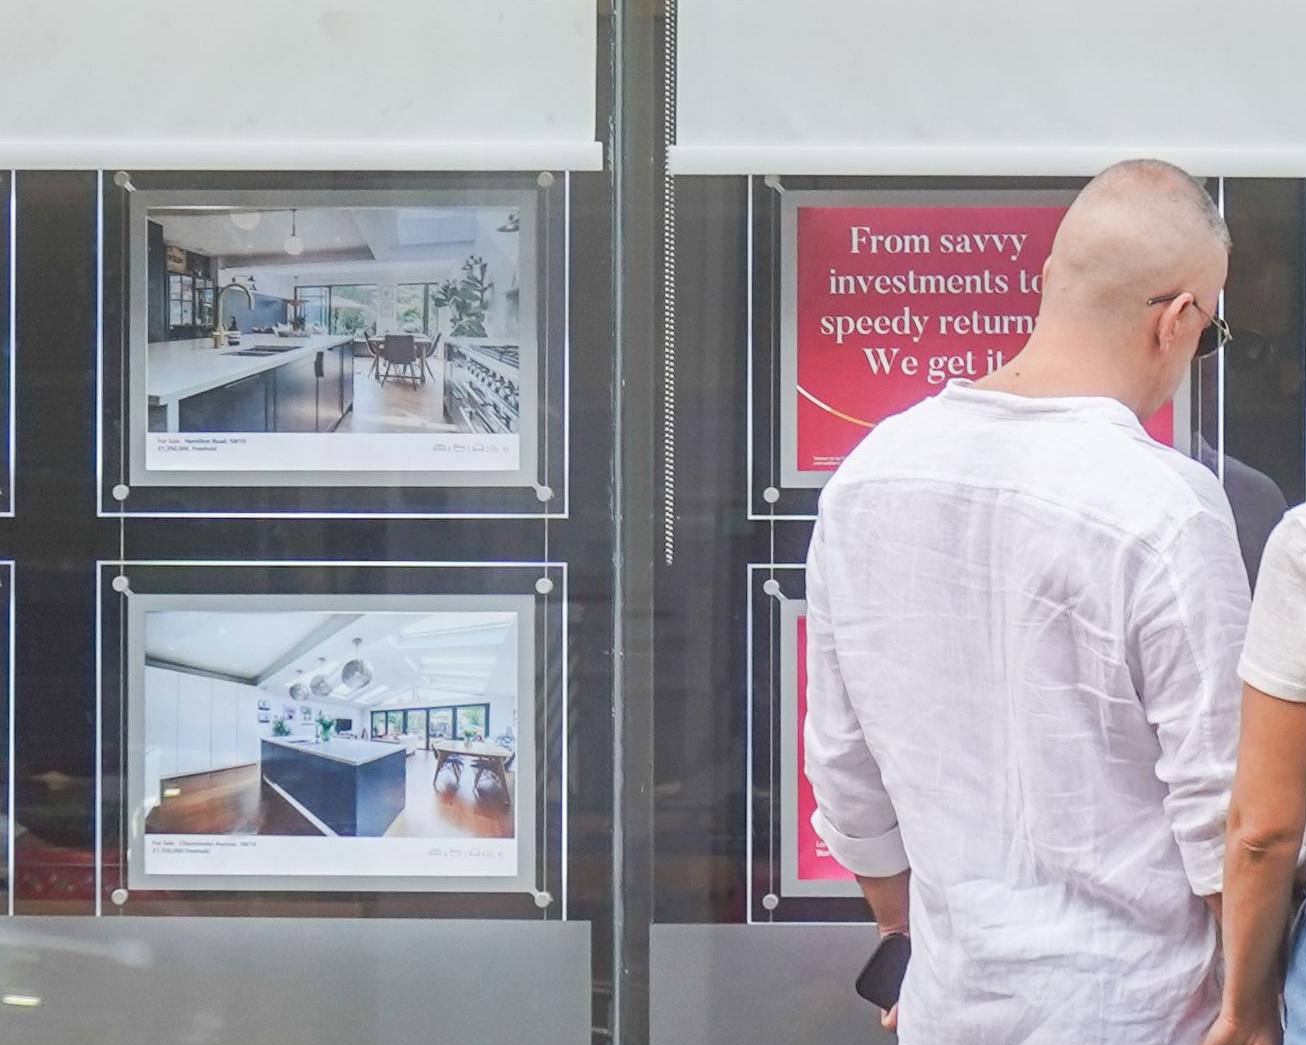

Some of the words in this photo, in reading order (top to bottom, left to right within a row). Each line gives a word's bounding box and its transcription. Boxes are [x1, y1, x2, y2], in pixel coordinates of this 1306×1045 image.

[850, 225, 930, 254] From
[939, 233, 1027, 261] savvy
[829, 268, 1009, 294] investments
[820, 306, 929, 344] speedy
[863, 347, 919, 375] We
[926, 351, 977, 384] get
